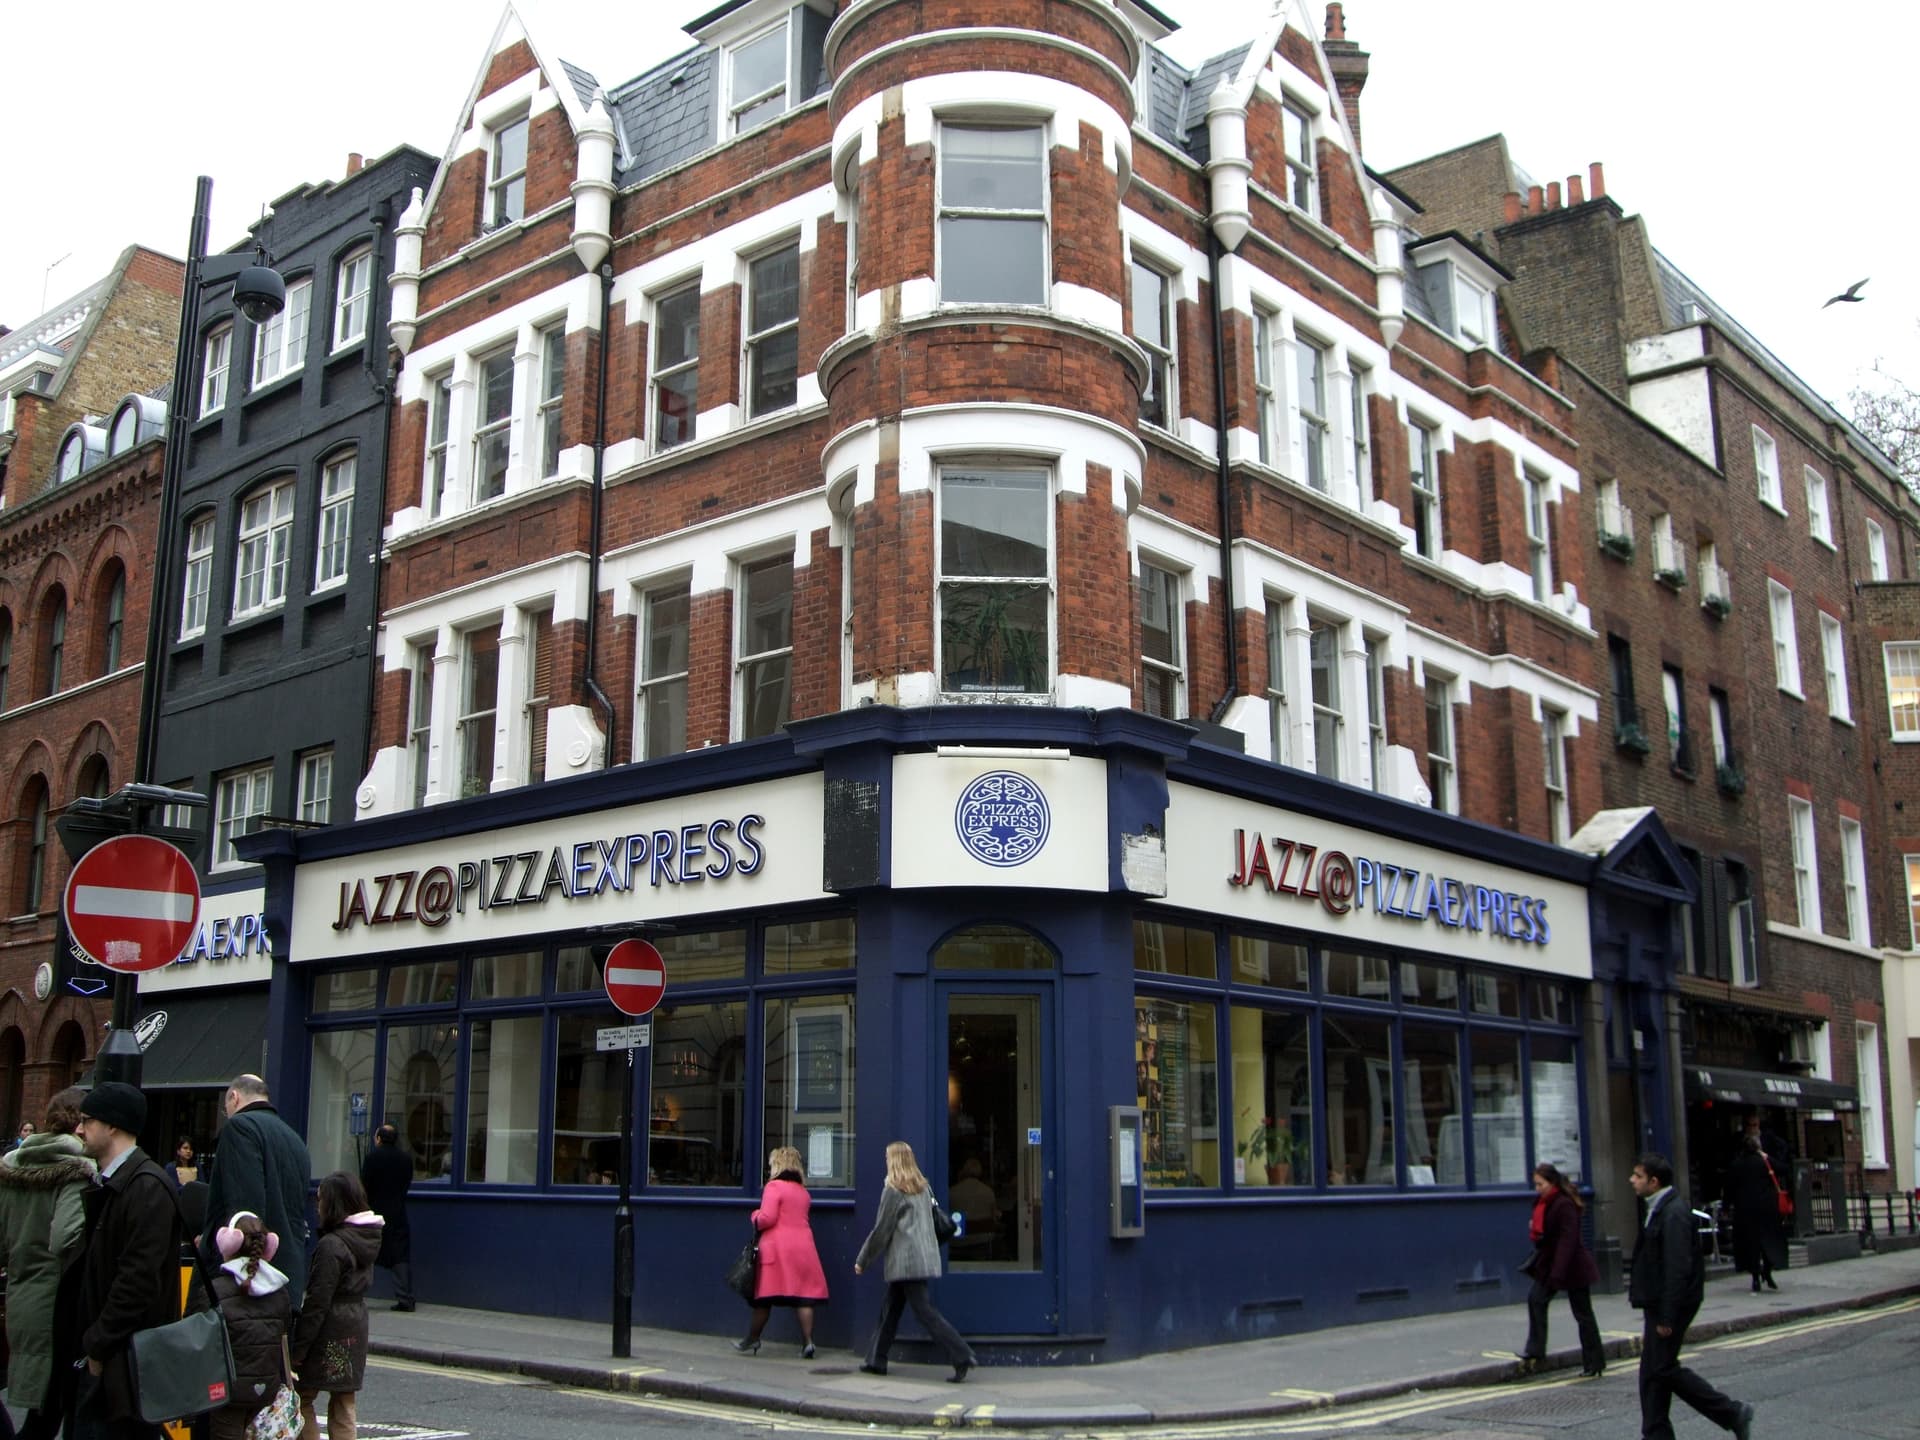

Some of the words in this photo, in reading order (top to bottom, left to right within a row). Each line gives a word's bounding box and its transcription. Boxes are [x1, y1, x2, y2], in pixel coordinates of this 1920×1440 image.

[967, 815, 1039, 828] EXPRESS
[981, 803, 1027, 816] PIZZA
[332, 814, 767, 930] JAZZ@PIZZAEXPRESS
[1227, 828, 1551, 945] JAZZ@PIZZAEXPRESS
